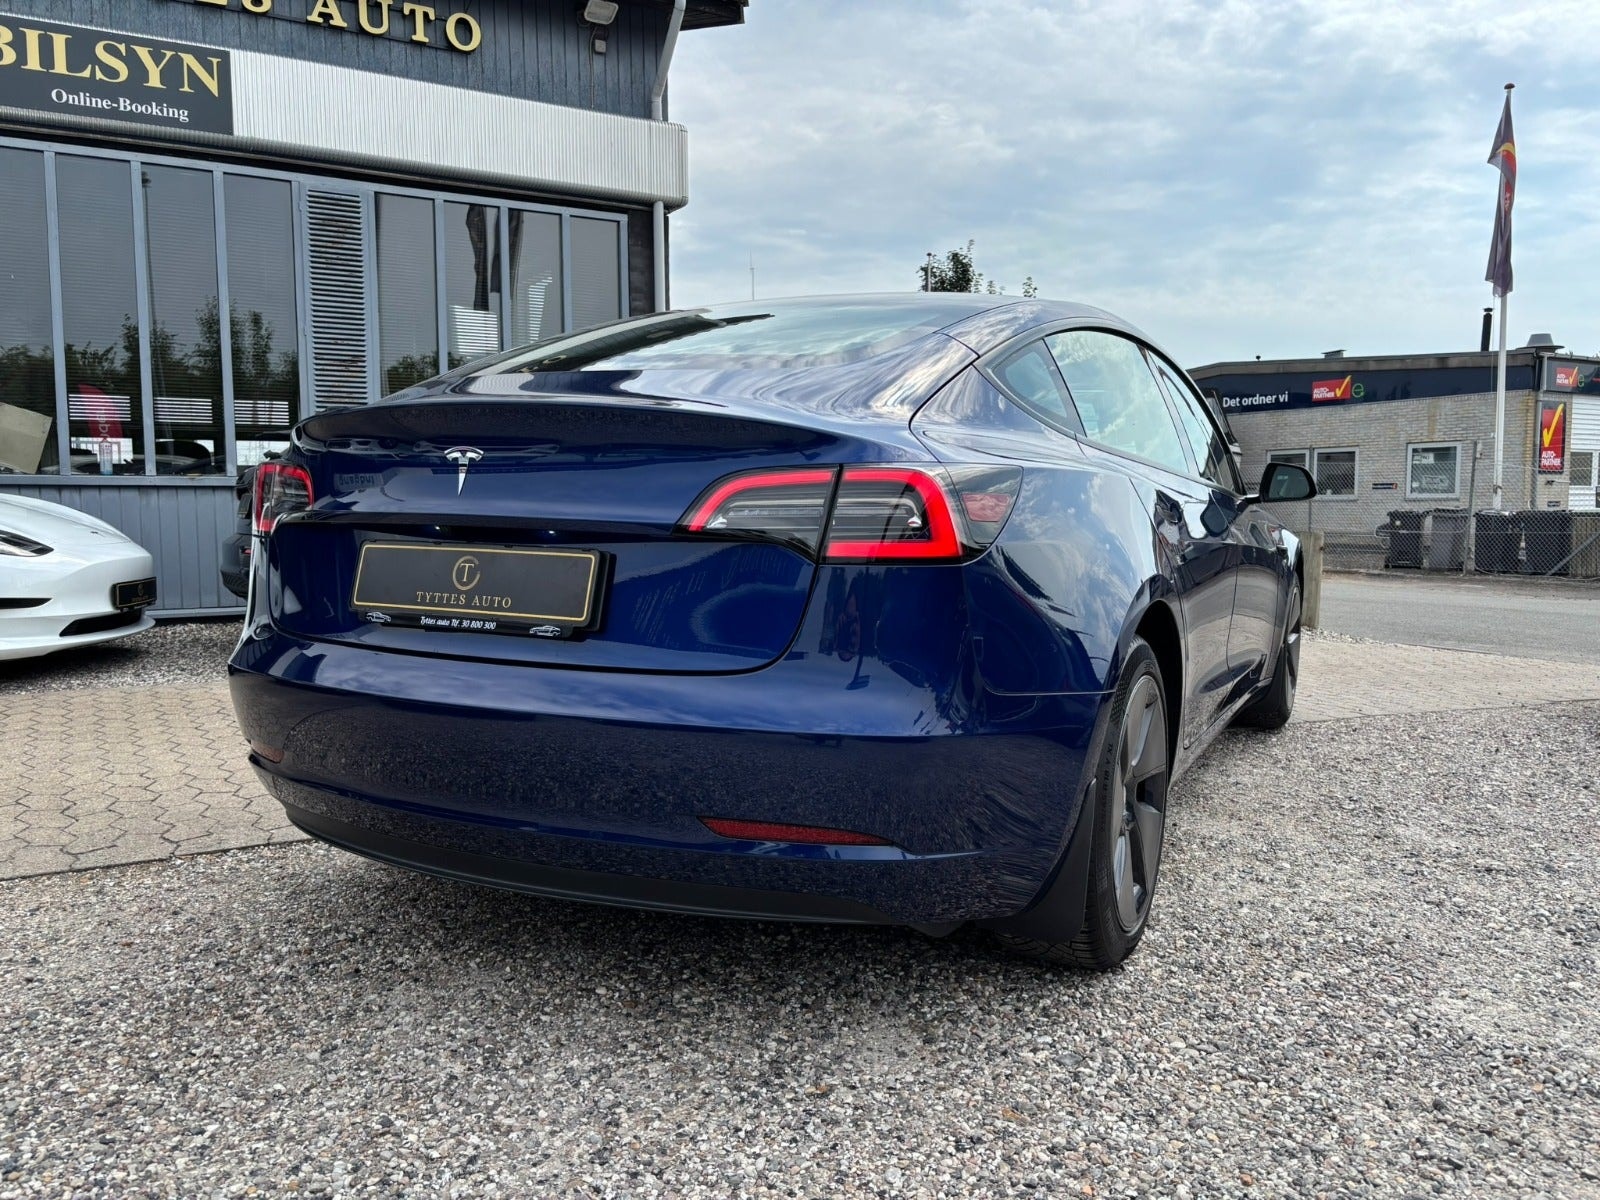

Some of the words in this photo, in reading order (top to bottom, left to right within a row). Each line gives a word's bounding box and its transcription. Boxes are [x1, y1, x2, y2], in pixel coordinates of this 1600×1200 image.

[307, 0, 482, 51] AUTO
[51, 88, 189, 123] Online-Booking
[1222, 396, 1240, 408] Det
[1242, 393, 1276, 406] ordner
[1278, 391, 1288, 402] vi
[416, 591, 466, 605] TYTTES
[471, 594, 512, 608] AUTO
[461, 620, 470, 628] 30
[470, 621, 483, 629] 800
[483, 622, 497, 630] 300
